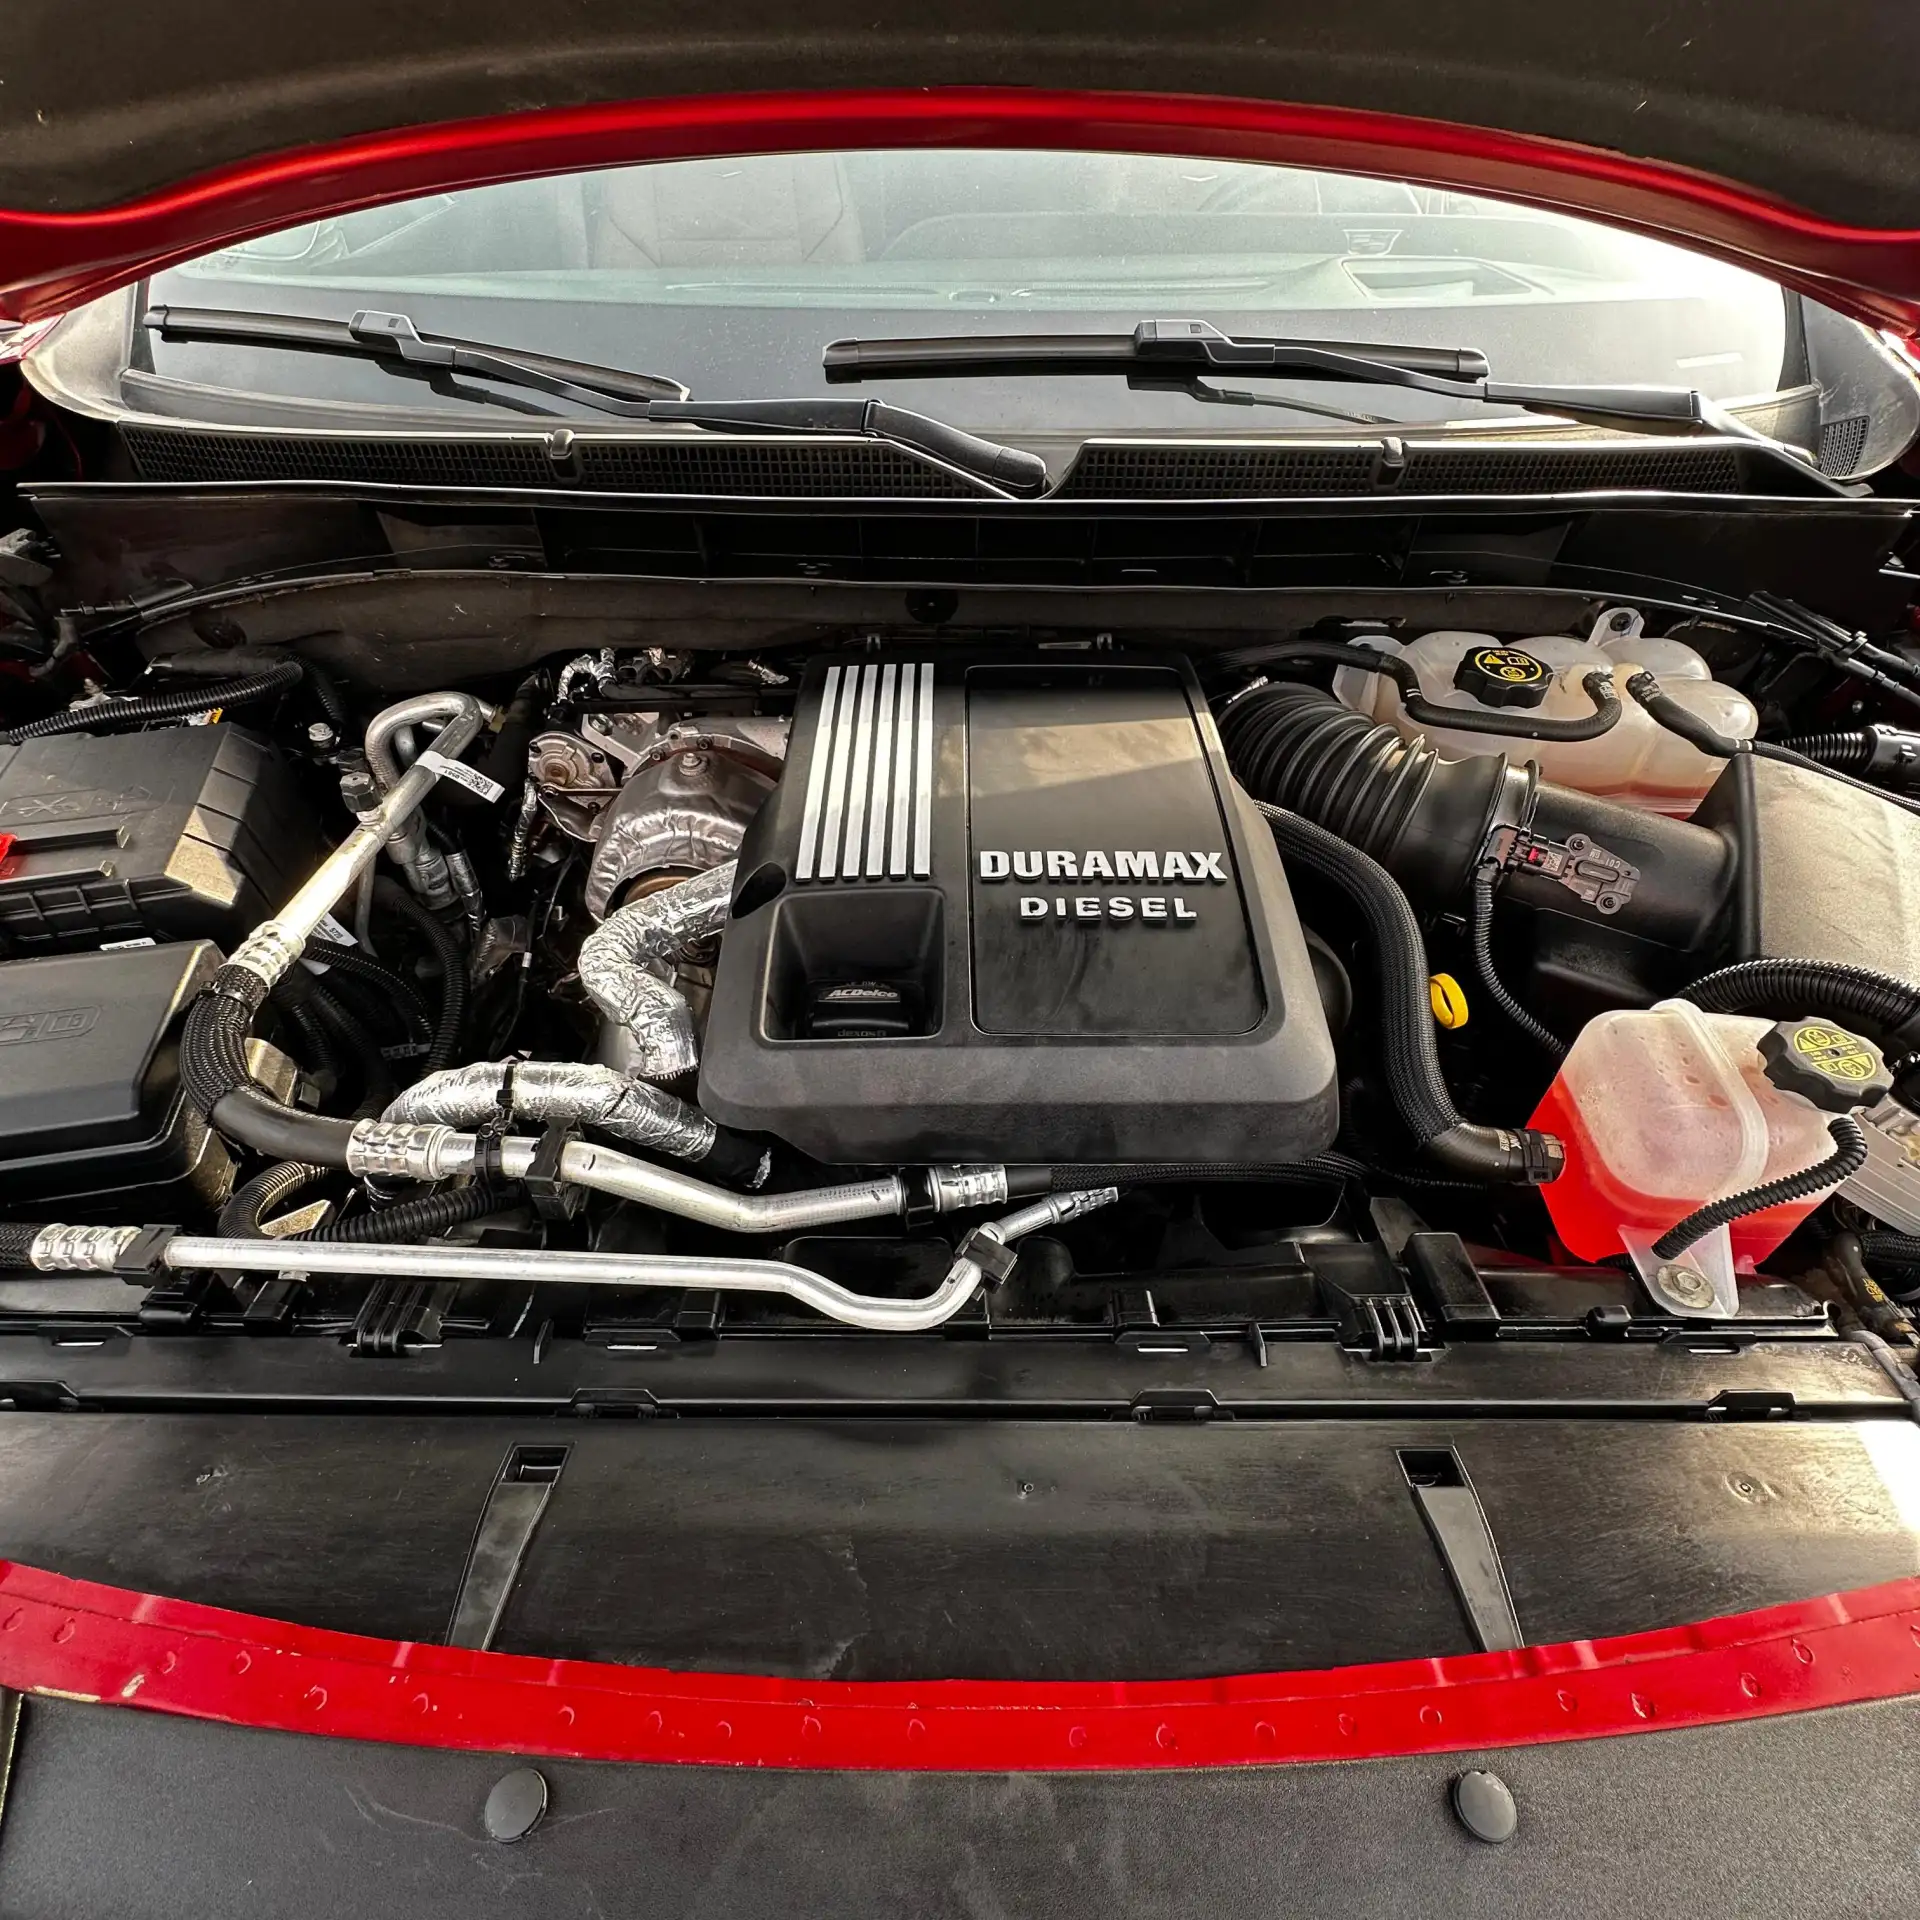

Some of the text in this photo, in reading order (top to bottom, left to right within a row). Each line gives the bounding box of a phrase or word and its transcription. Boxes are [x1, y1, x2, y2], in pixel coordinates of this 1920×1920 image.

[979, 850, 1228, 881] DURAMAX
[1019, 897, 1198, 920] DIESEL
[828, 989, 898, 998] ACDelco
